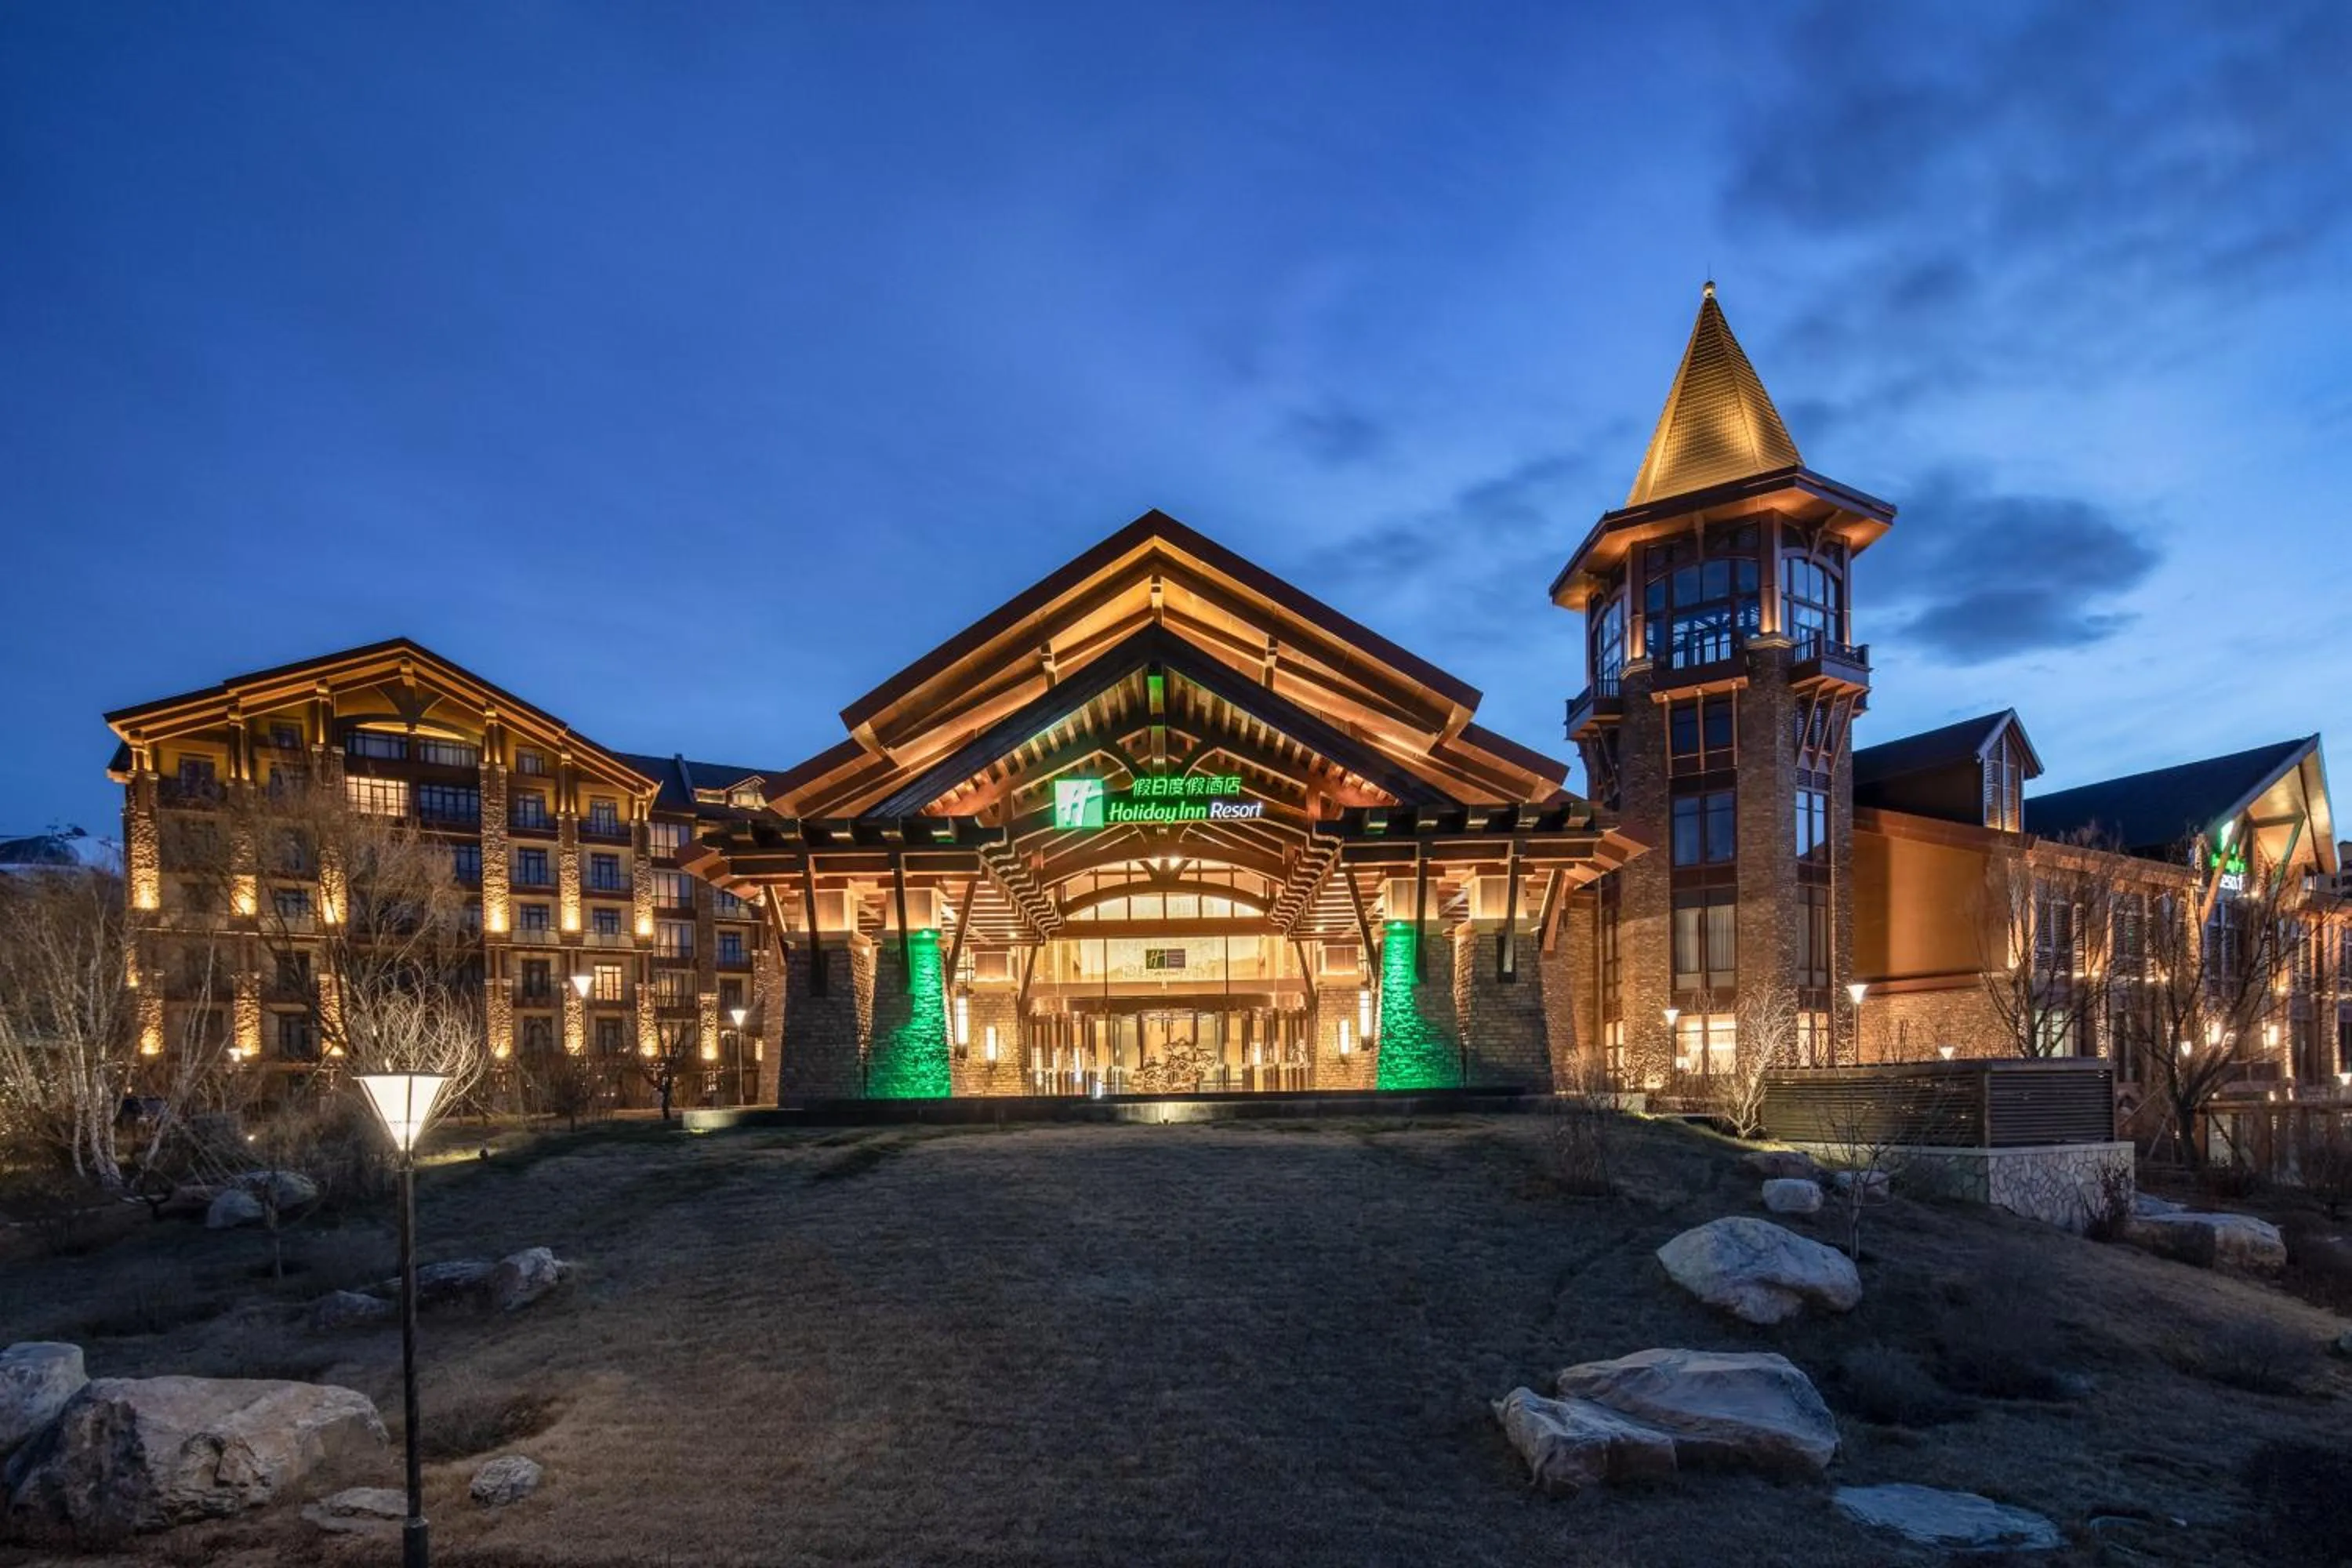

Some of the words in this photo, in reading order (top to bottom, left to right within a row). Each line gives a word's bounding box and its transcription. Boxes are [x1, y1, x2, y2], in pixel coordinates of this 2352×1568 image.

[1133, 776, 1241, 797] 假日度假酒店
[1109, 801, 1176, 823] Holiday
[1178, 801, 1207, 819] Inn
[1210, 801, 1264, 819] Resort
